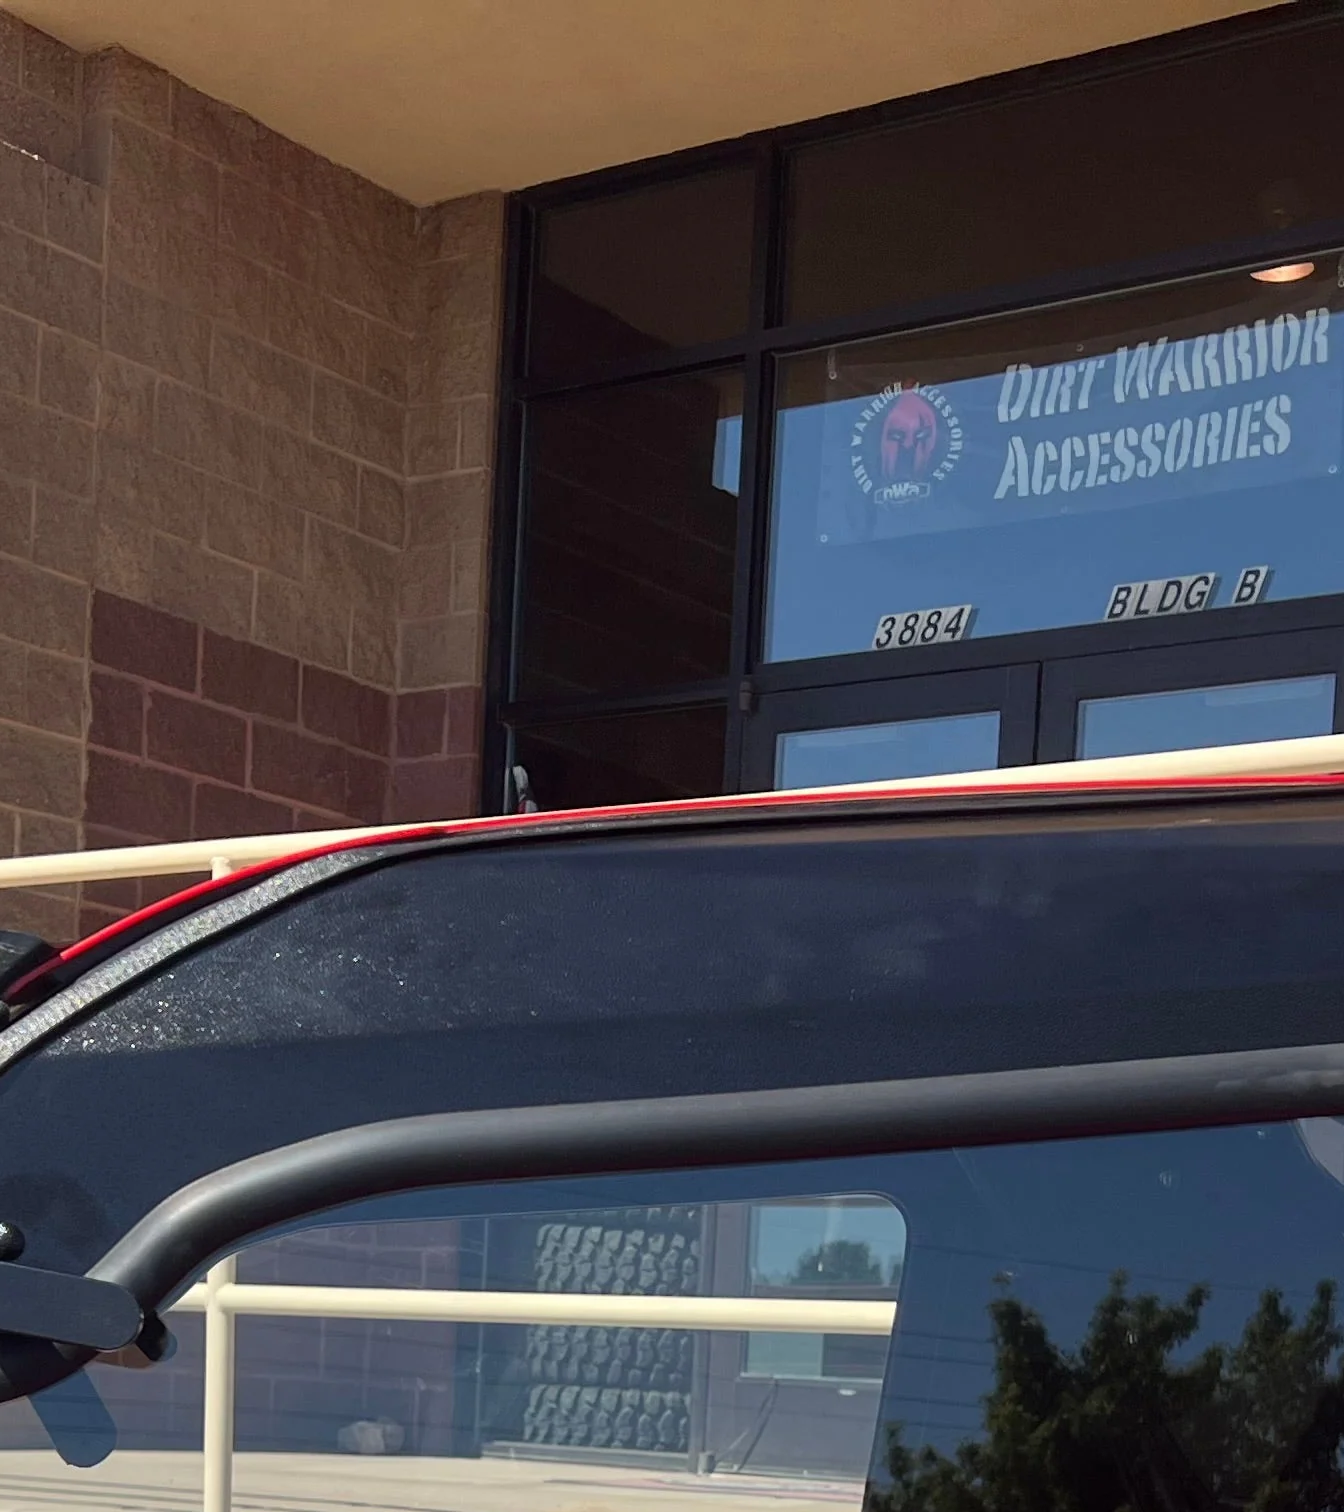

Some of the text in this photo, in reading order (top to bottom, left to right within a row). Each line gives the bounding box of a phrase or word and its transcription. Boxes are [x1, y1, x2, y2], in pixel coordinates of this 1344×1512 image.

[997, 307, 1330, 423] DIRT WARRIOR
[994, 394, 1292, 499] ACCESSORIES
[875, 607, 964, 649] 3884
[1107, 568, 1261, 619] BLDG B
